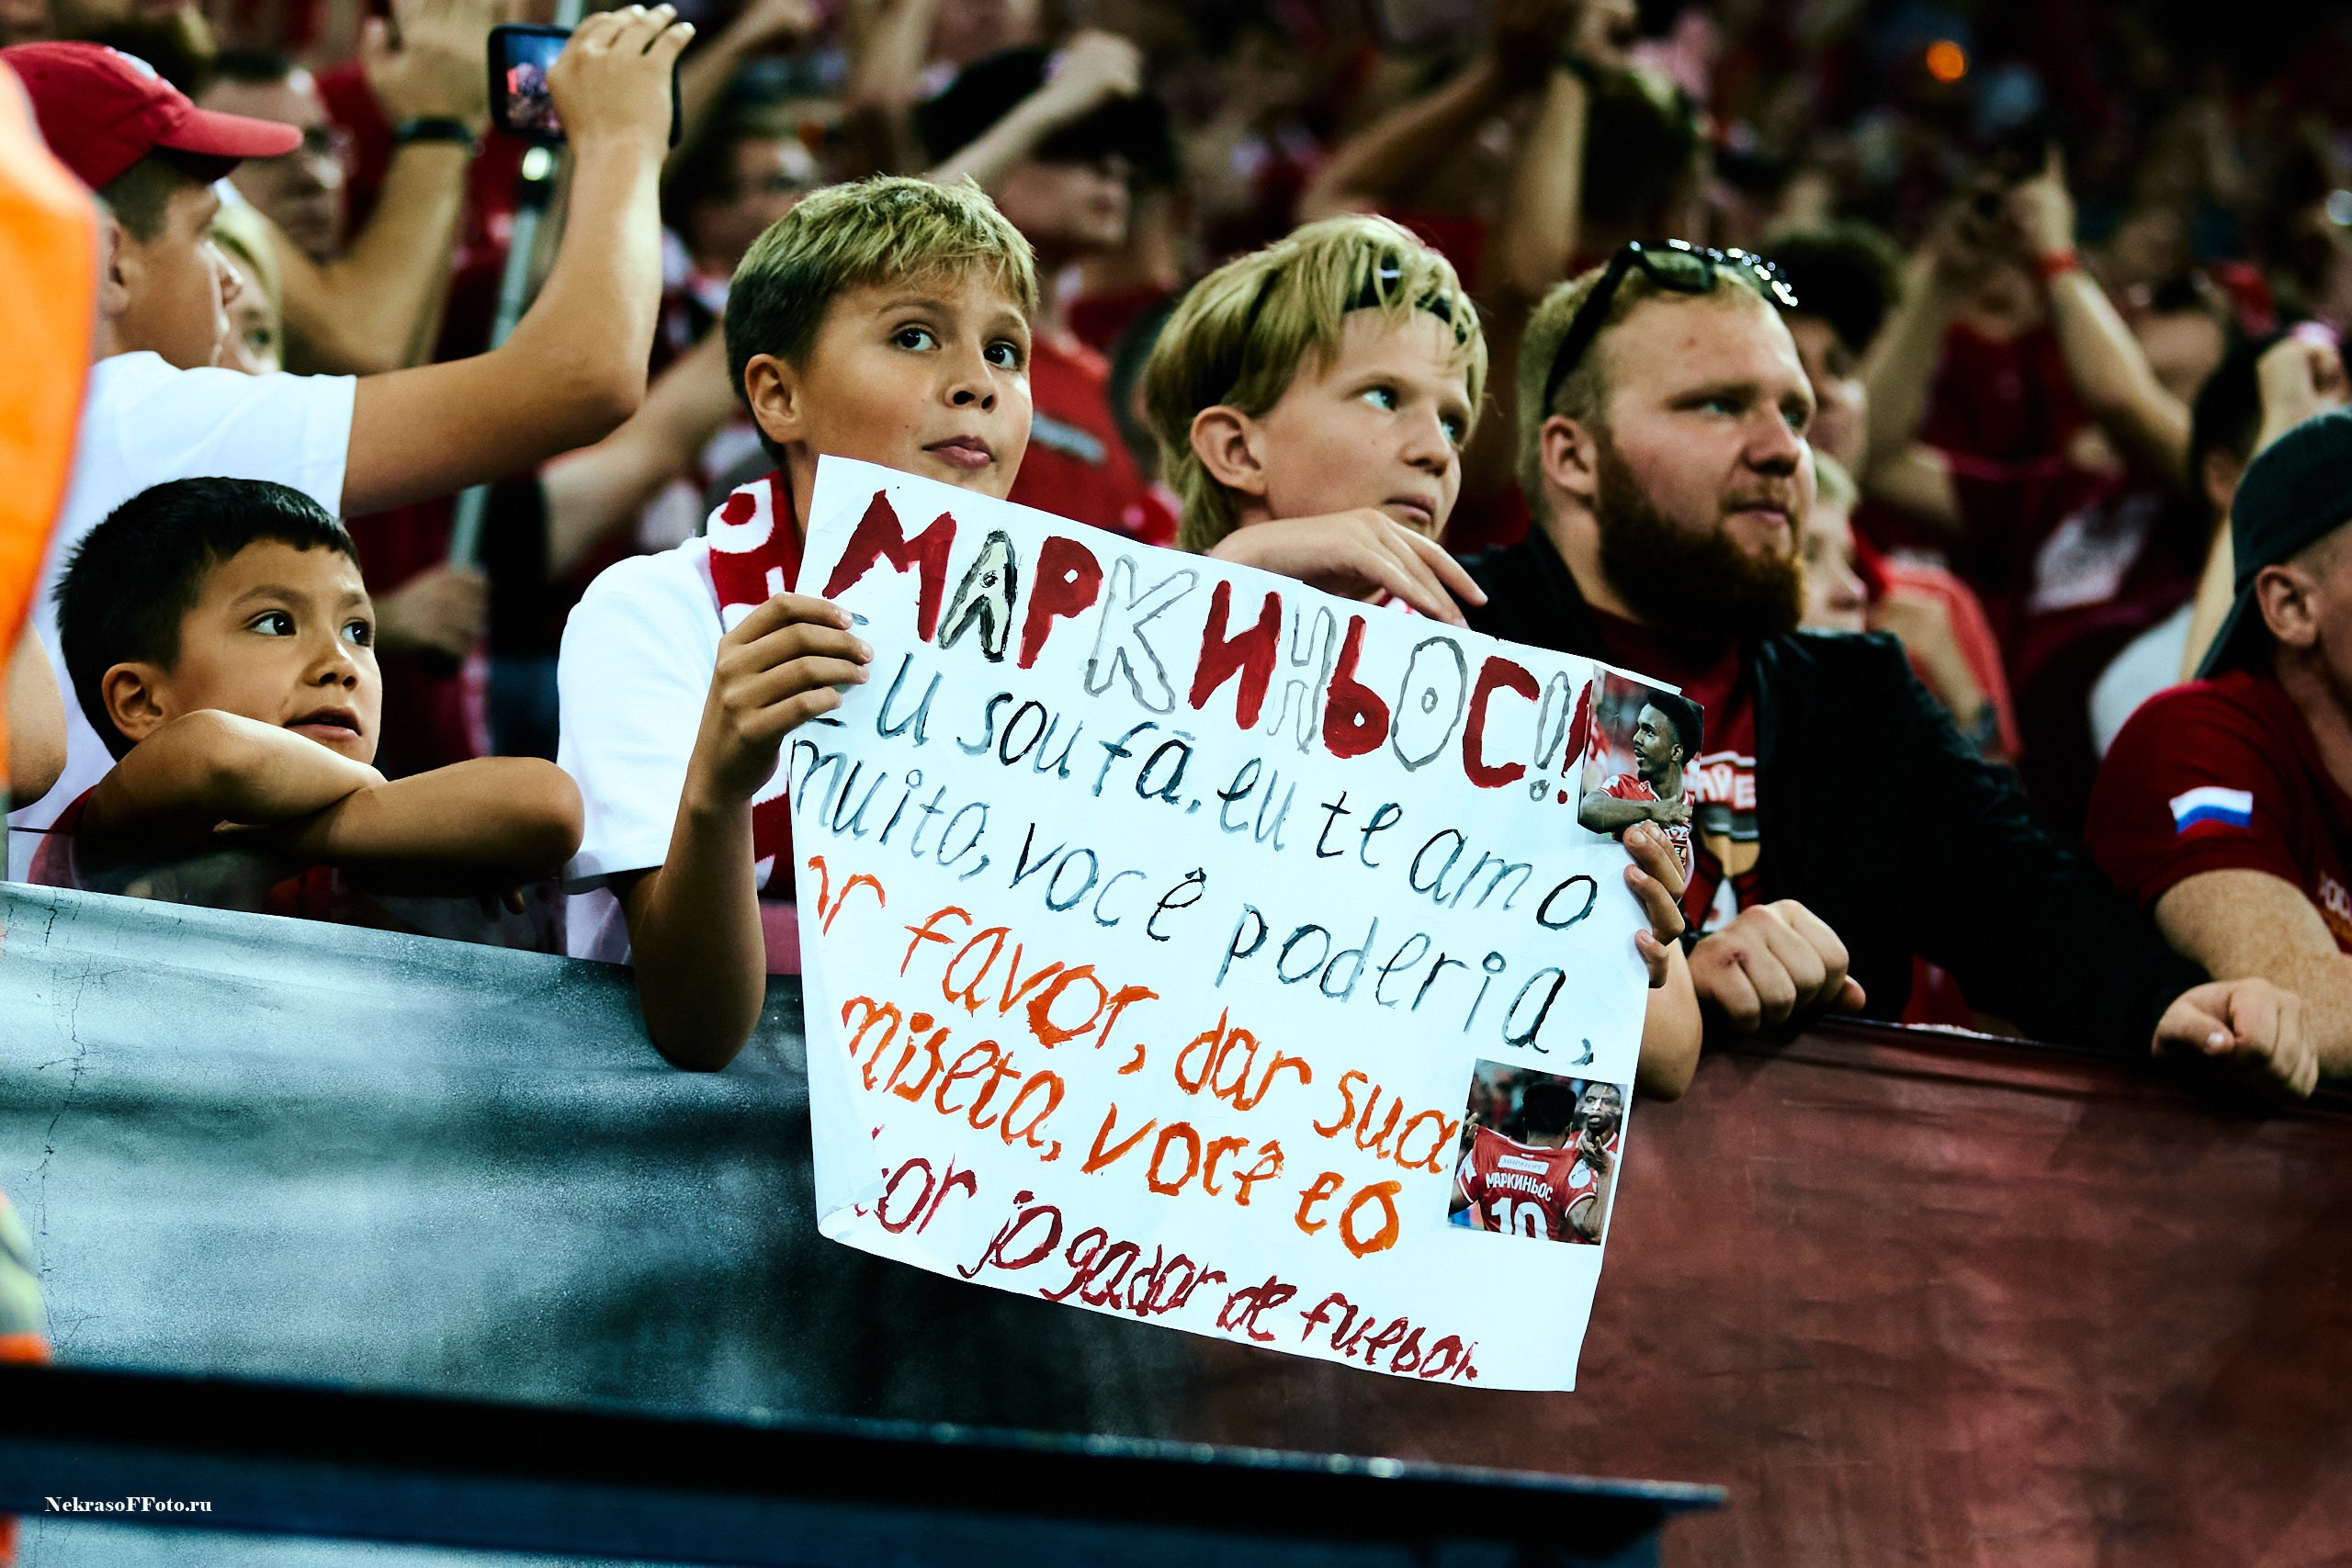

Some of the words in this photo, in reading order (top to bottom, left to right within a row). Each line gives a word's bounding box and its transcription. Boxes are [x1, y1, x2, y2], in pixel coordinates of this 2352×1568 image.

[956, 692, 1084, 779] sou
[1217, 757, 1297, 852] eu
[1317, 790, 1403, 868] te
[1409, 829, 1599, 931] amo
[790, 739, 990, 882] muito,
[1009, 822, 1207, 942] você
[1216, 903, 1594, 1067] poderia,
[841, 995, 1063, 1162] miseta,
[899, 905, 1159, 1074] favor,
[1174, 1006, 1313, 1111] dar
[1313, 1069, 1461, 1174] sua
[1485, 1172, 1555, 1201] МАРКИНЬОС
[1490, 1197, 1549, 1240] 10
[1216, 1274, 1297, 1342] de
